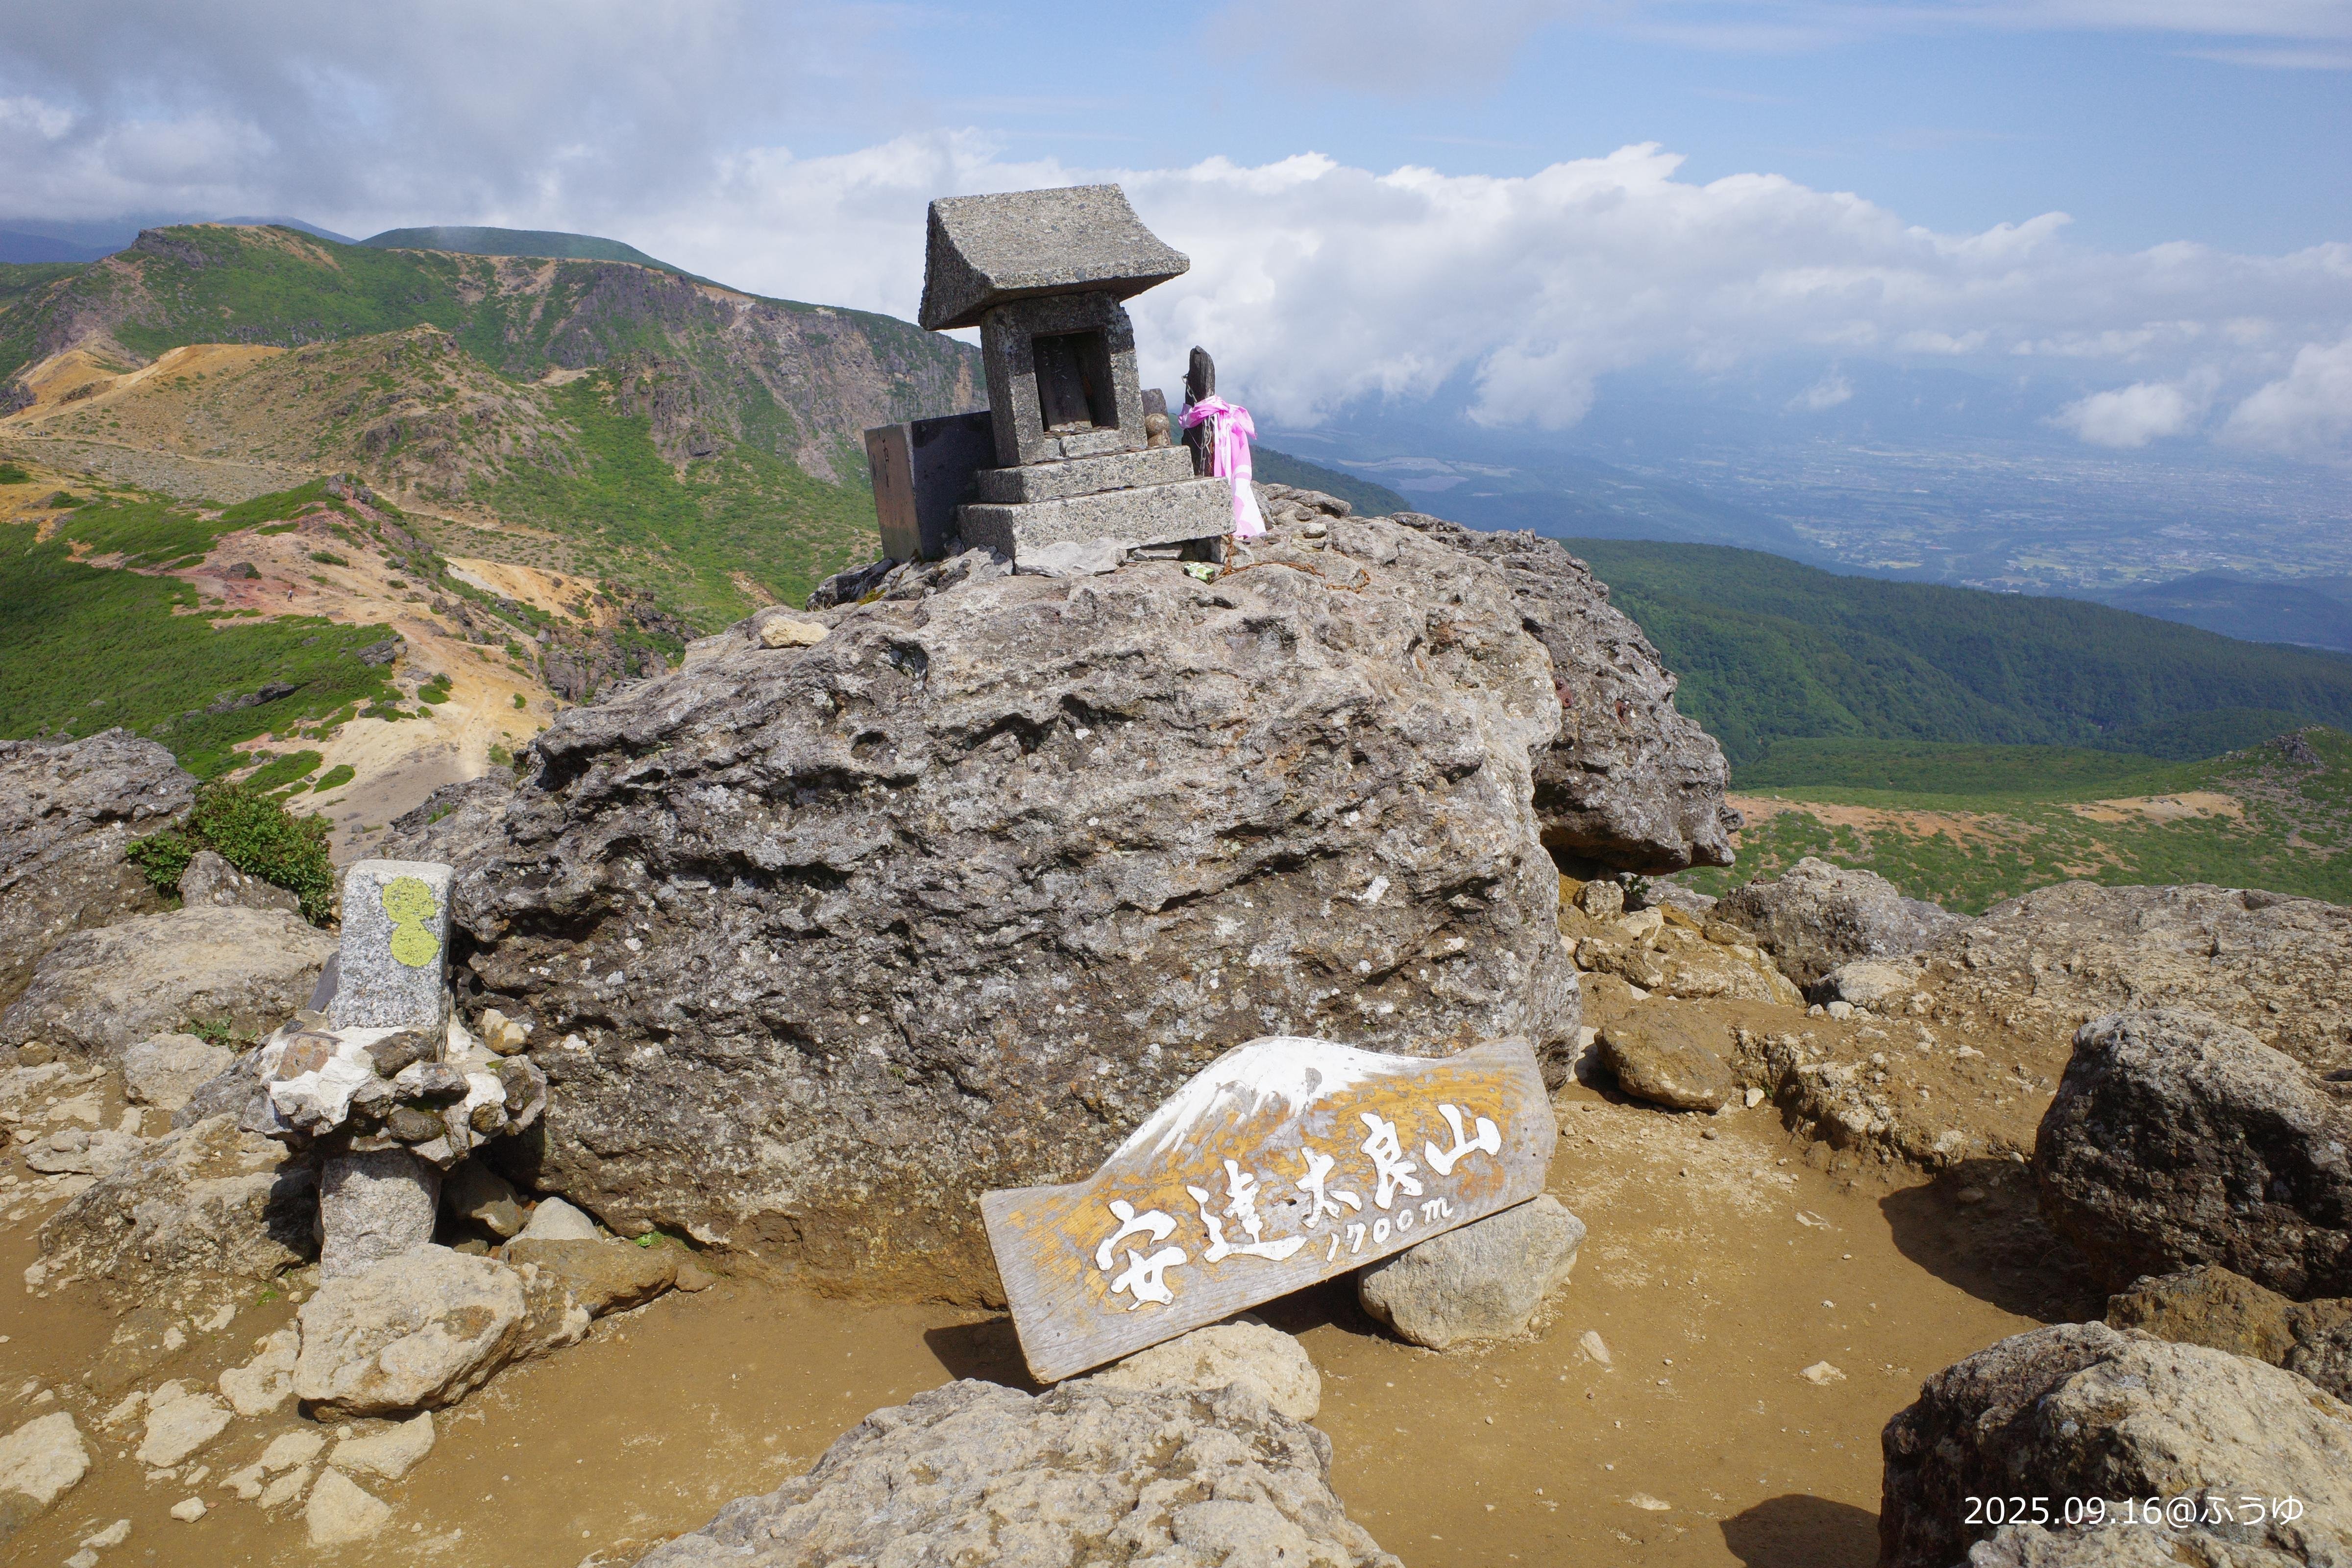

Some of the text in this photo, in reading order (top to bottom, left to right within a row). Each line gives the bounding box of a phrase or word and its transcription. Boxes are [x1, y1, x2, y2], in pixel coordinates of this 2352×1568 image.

[1096, 1104, 1502, 1310] 安達太良山
